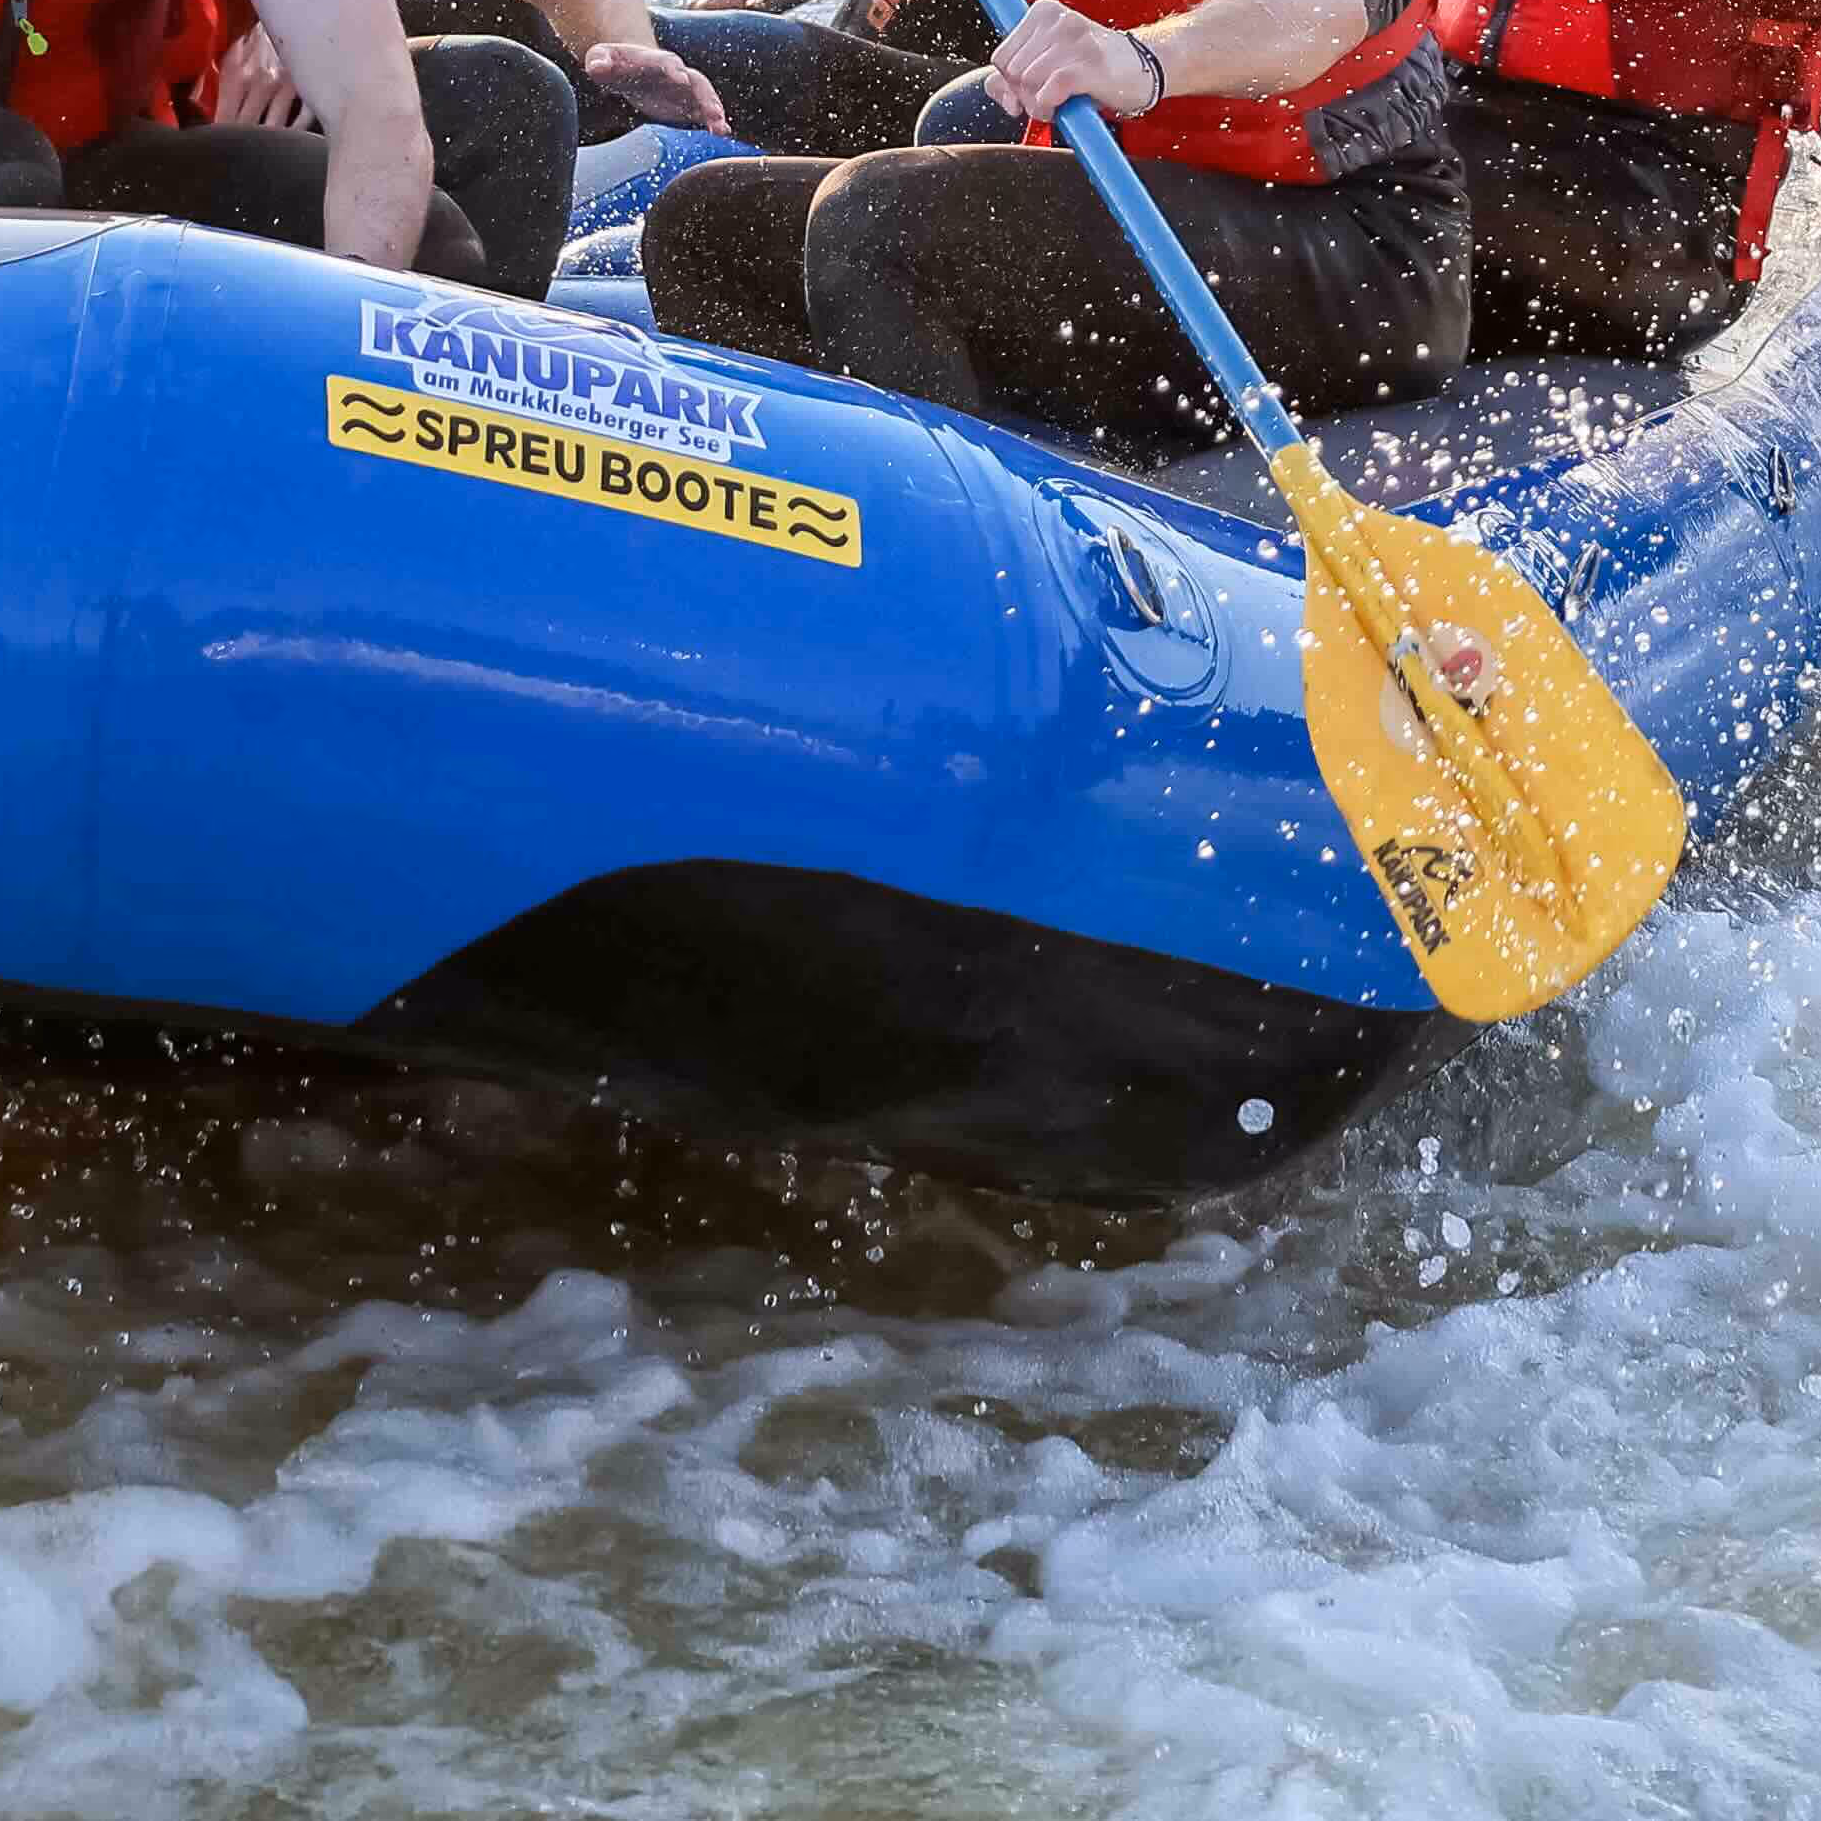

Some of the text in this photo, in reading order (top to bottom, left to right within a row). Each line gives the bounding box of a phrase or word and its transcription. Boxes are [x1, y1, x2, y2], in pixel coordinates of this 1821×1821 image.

[373, 307, 758, 438] KANUPARK
[422, 368, 721, 454] am Markkleeberger See
[414, 407, 779, 532] SPREU BOOTE
